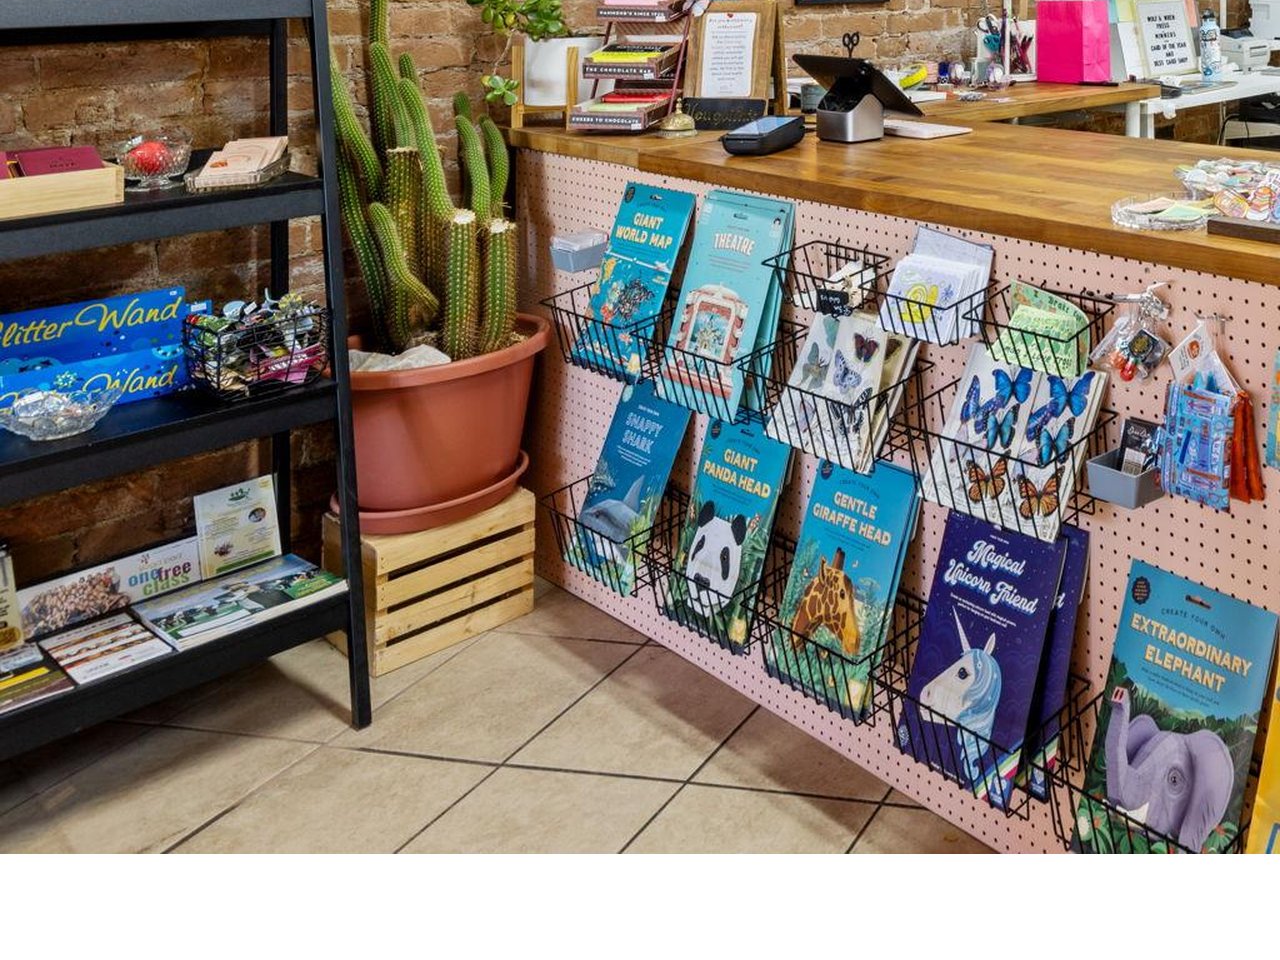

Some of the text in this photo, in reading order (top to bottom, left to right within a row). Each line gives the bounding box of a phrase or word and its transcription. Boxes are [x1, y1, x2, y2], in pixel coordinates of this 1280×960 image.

[633, 212, 664, 230] GIANT
[615, 225, 673, 249] WORLD MAP
[714, 233, 756, 256] THEATRE
[75, 297, 183, 332] Wand
[625, 412, 664, 438] SNAPPY
[622, 429, 654, 454] SHARK
[724, 448, 758, 473] GIANT
[703, 459, 771, 498] PANDA HEAD
[834, 491, 878, 520] GENTLE
[812, 502, 892, 546] GIRAFFE HEAD
[967, 540, 1026, 575] Magical
[128, 560, 192, 588] one free
[142, 572, 191, 597] class
[944, 558, 992, 594] Unicorn
[990, 581, 1039, 614] Friend
[1161, 607, 1226, 640] CREATE YOUR OWN
[1130, 612, 1253, 677] EXTRAORDINARY
[1144, 643, 1227, 693] ELEPHANT
